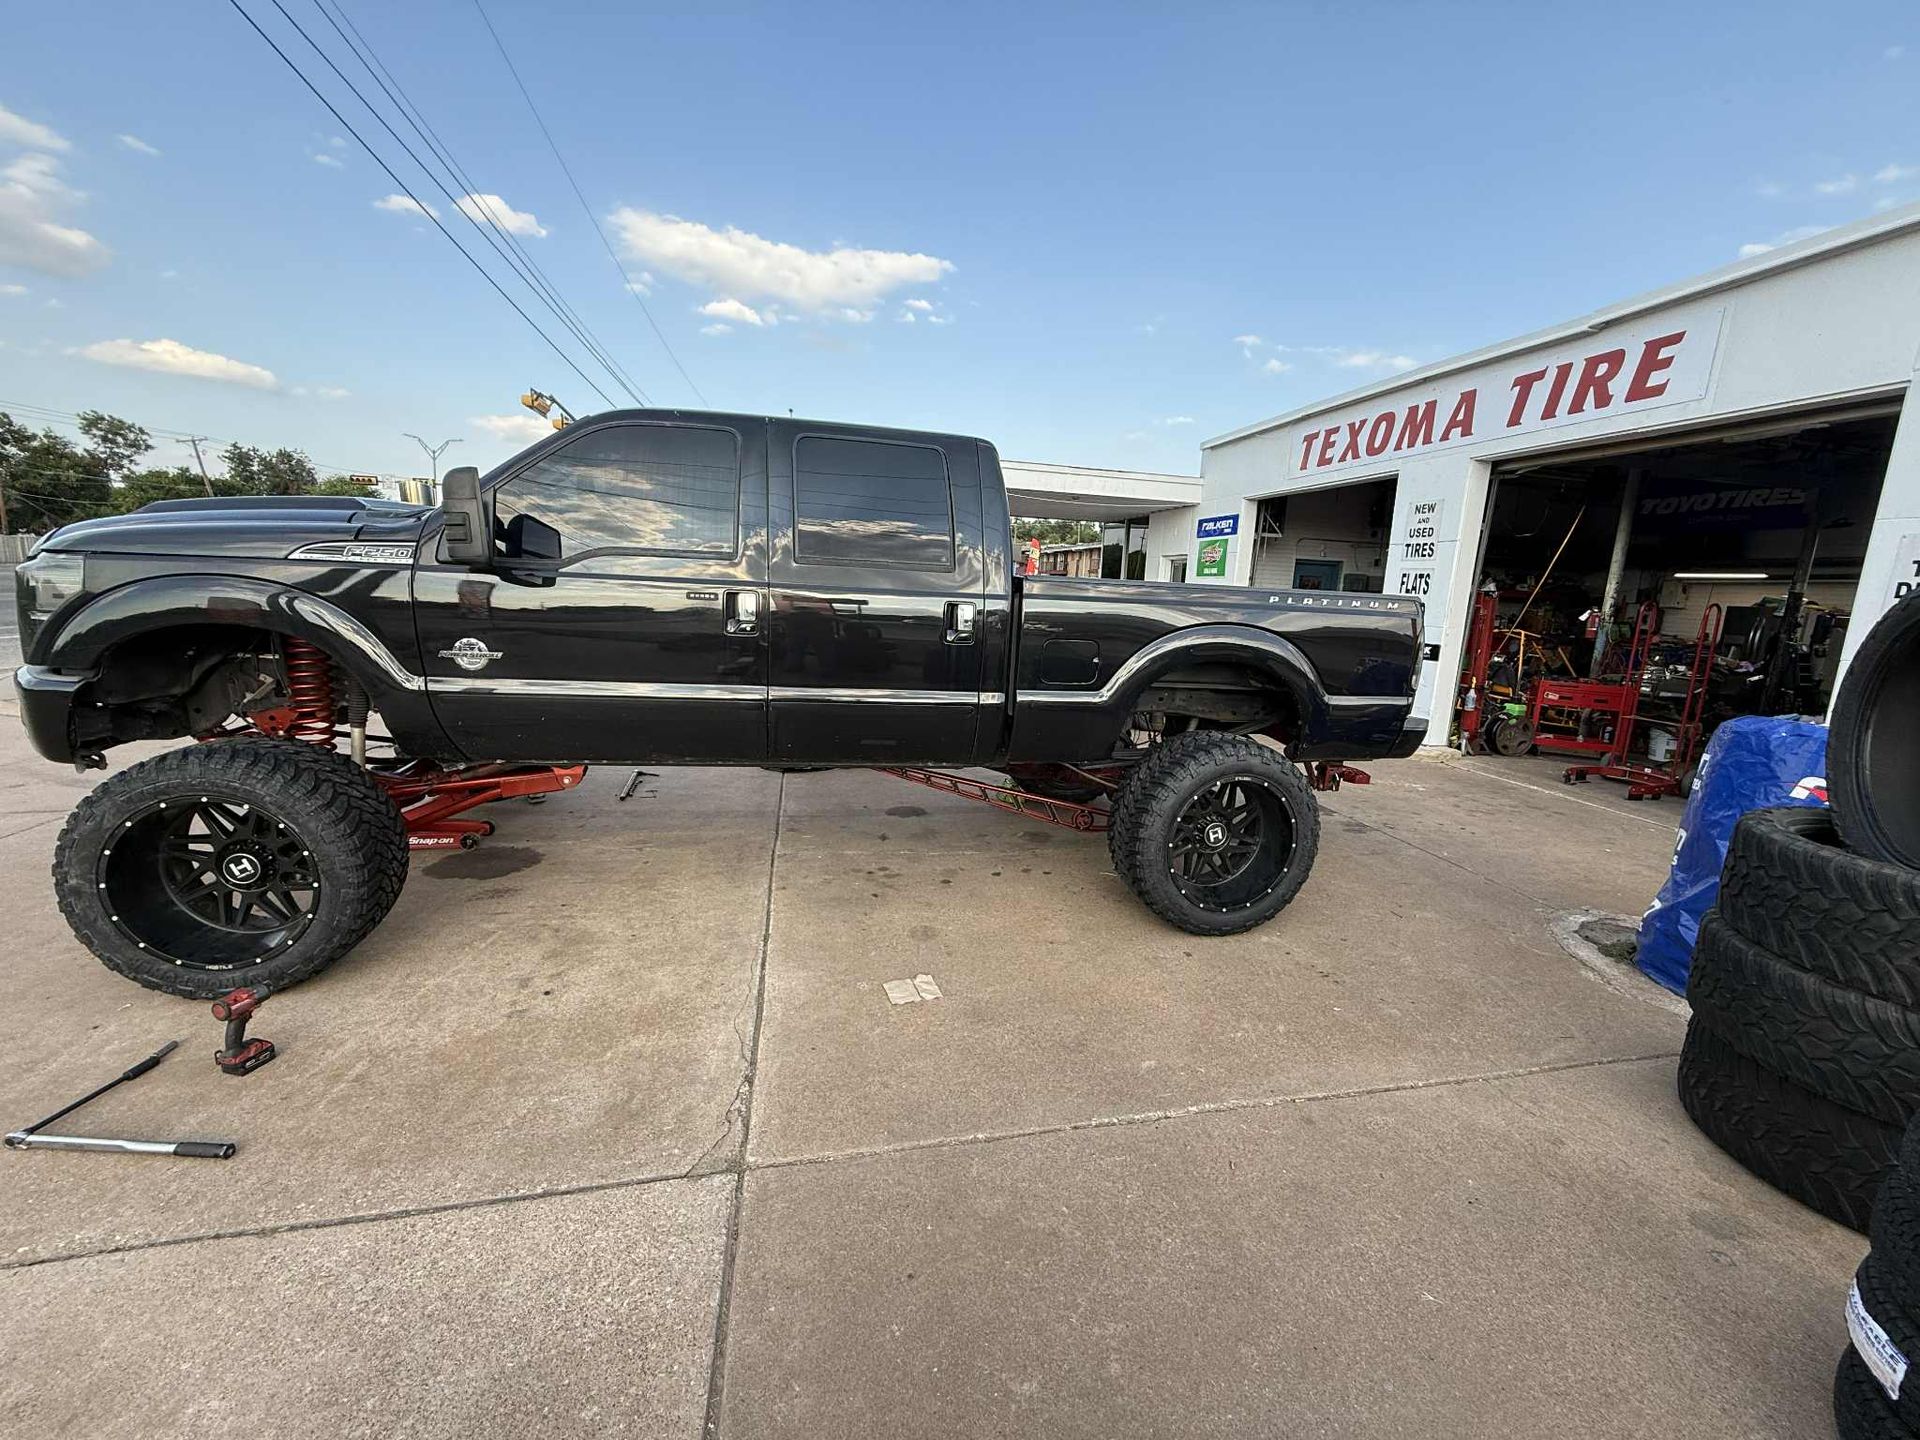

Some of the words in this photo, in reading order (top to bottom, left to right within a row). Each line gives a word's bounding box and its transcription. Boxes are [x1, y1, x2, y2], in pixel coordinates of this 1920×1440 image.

[1299, 388, 1478, 471] TEXOMA
[1506, 330, 1687, 428] TIRE
[1414, 502, 1437, 515] NEW
[1202, 520, 1233, 531] FALKEN
[1409, 527, 1434, 538] USED
[1405, 542, 1435, 558] TIRES
[1399, 573, 1431, 595] FLATS
[1269, 596, 1399, 610] PLATINUM
[408, 836, 454, 846] Snap-on
